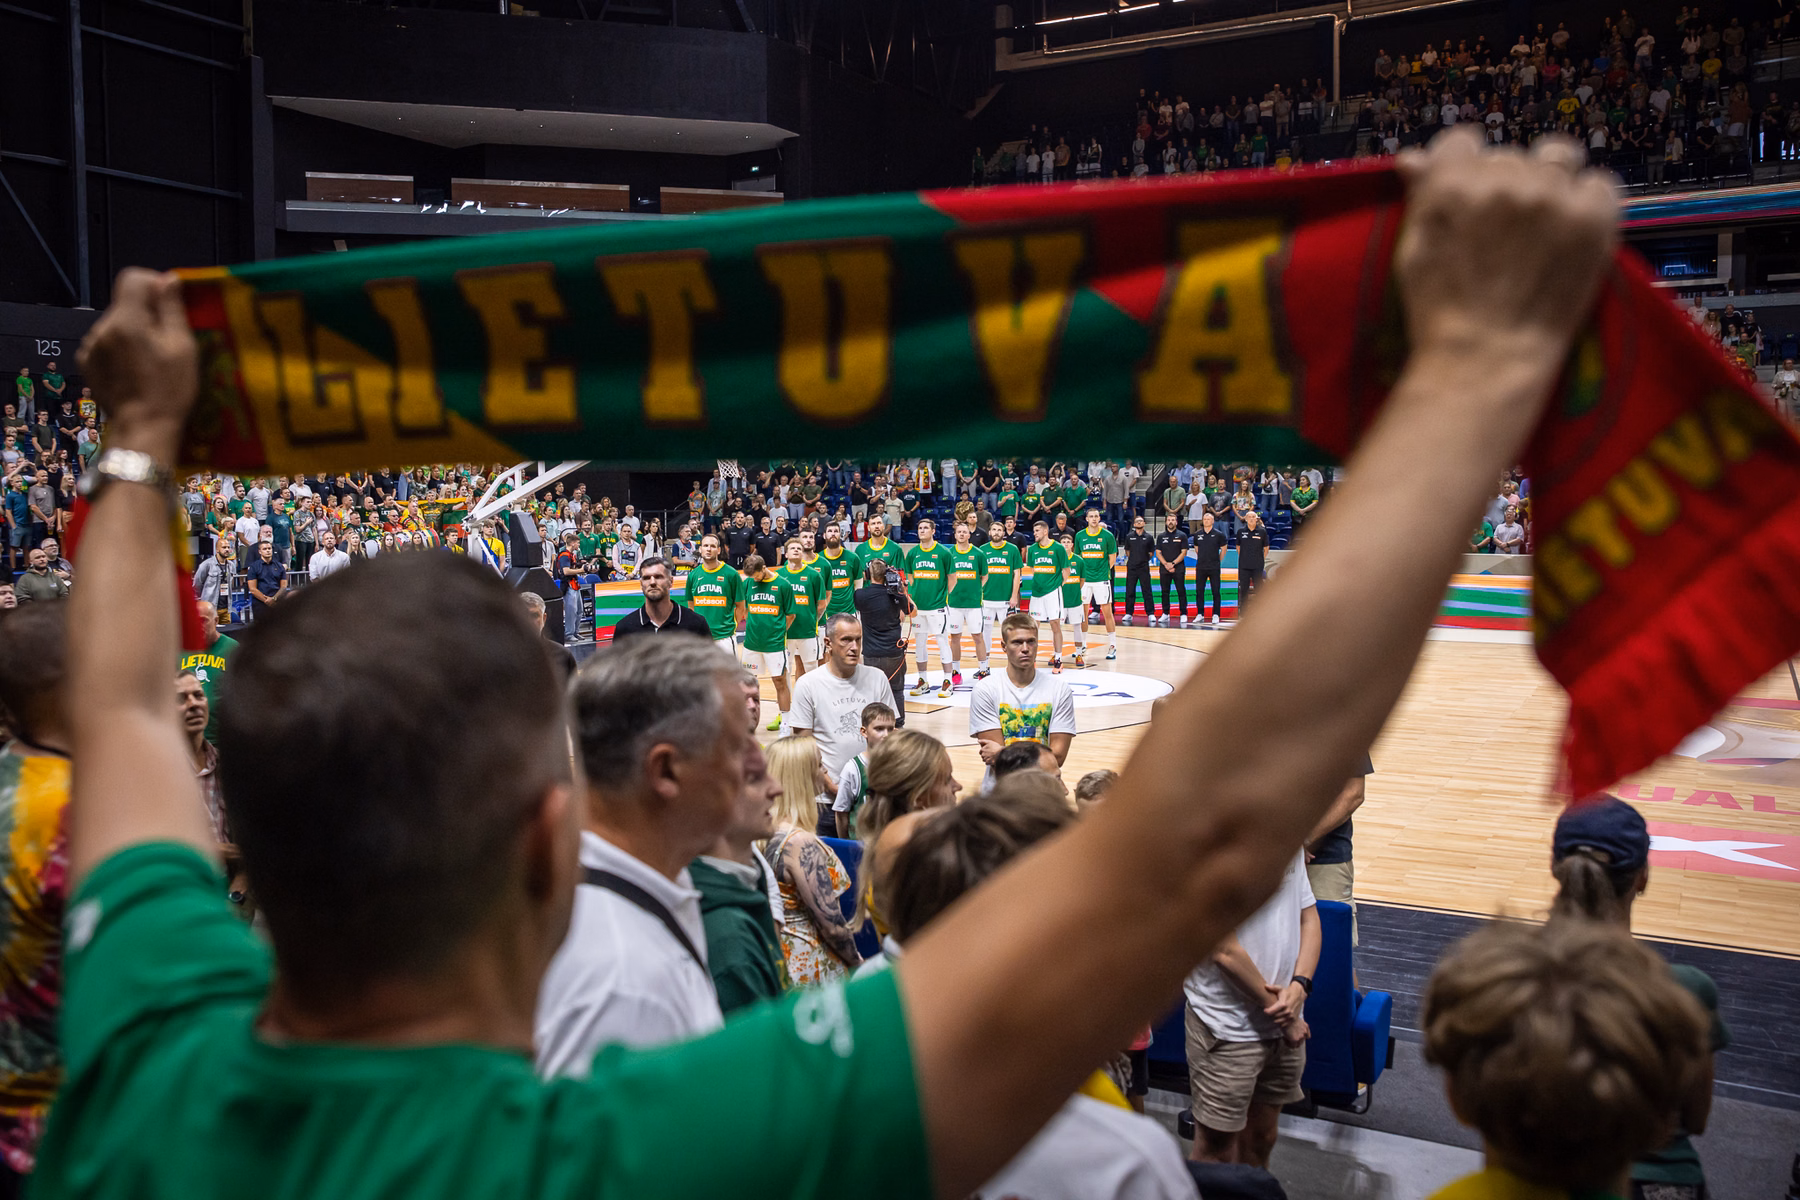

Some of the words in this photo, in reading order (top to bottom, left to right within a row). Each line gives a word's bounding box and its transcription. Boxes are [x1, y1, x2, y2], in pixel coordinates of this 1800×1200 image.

[257, 214, 1305, 448] LIETUVA
[35, 339, 61, 356] 125
[697, 584, 723, 594] LIETUVA
[695, 597, 725, 605] betsson
[750, 592, 776, 603] LIETUVA
[749, 606, 778, 614] betsson
[181, 653, 226, 671] LIETUVA
[832, 697, 867, 706] LIETUVA
